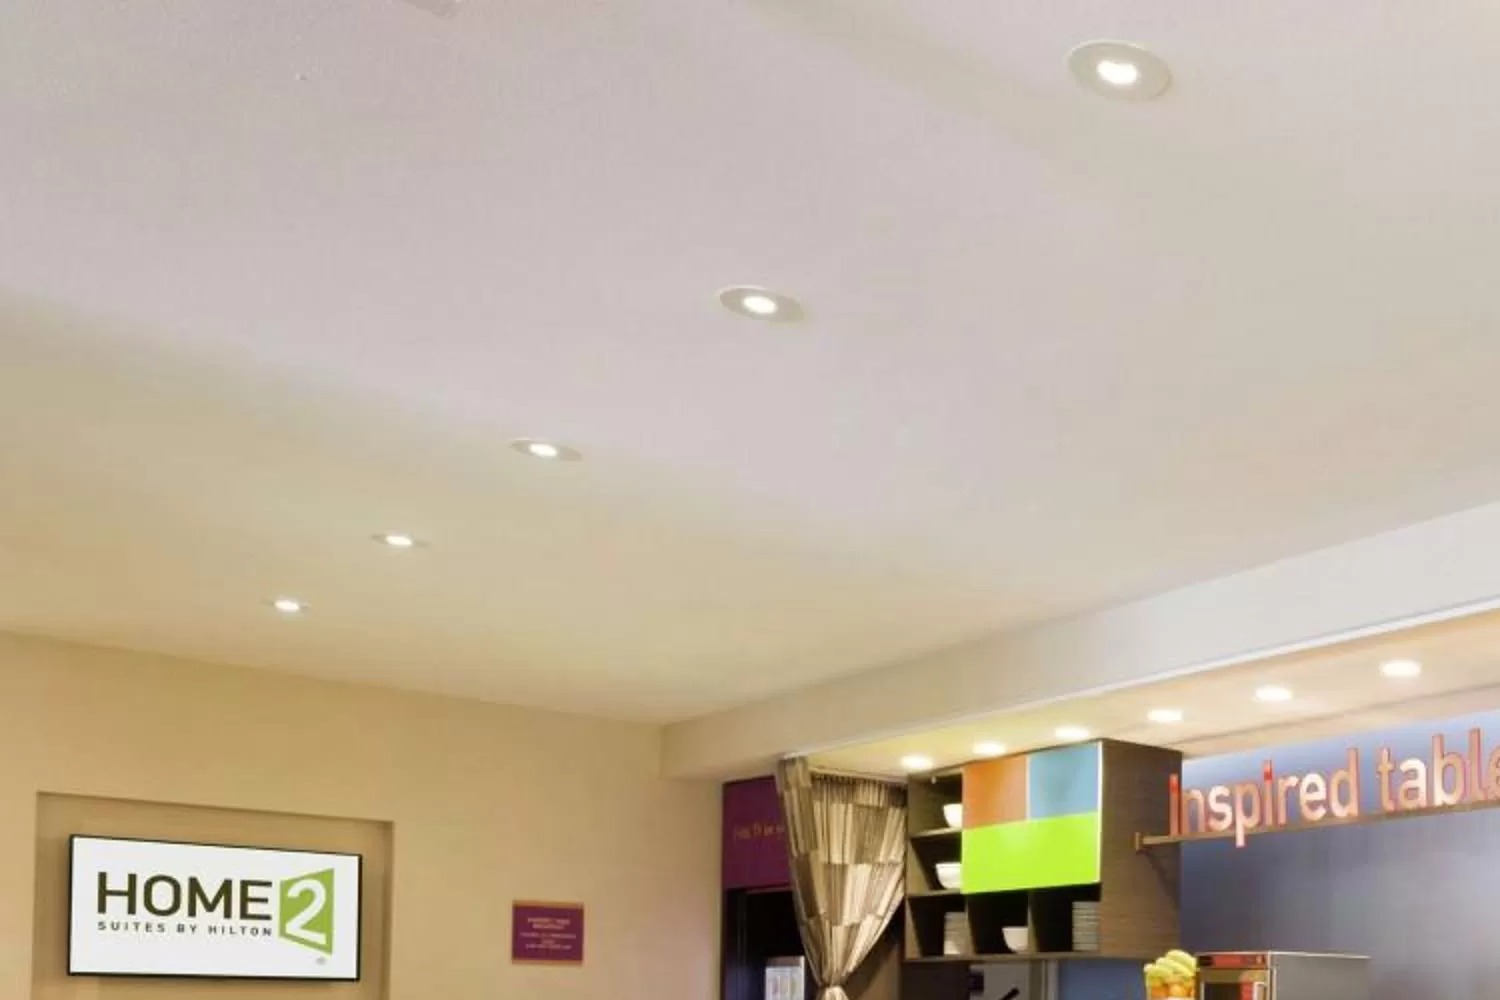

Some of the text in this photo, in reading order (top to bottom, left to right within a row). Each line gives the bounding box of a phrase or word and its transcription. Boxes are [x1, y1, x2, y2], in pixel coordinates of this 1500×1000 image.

[1168, 747, 1359, 848] inspired
[97, 871, 331, 947] HOME 2
[97, 920, 273, 937] SUITES BY HILTON
